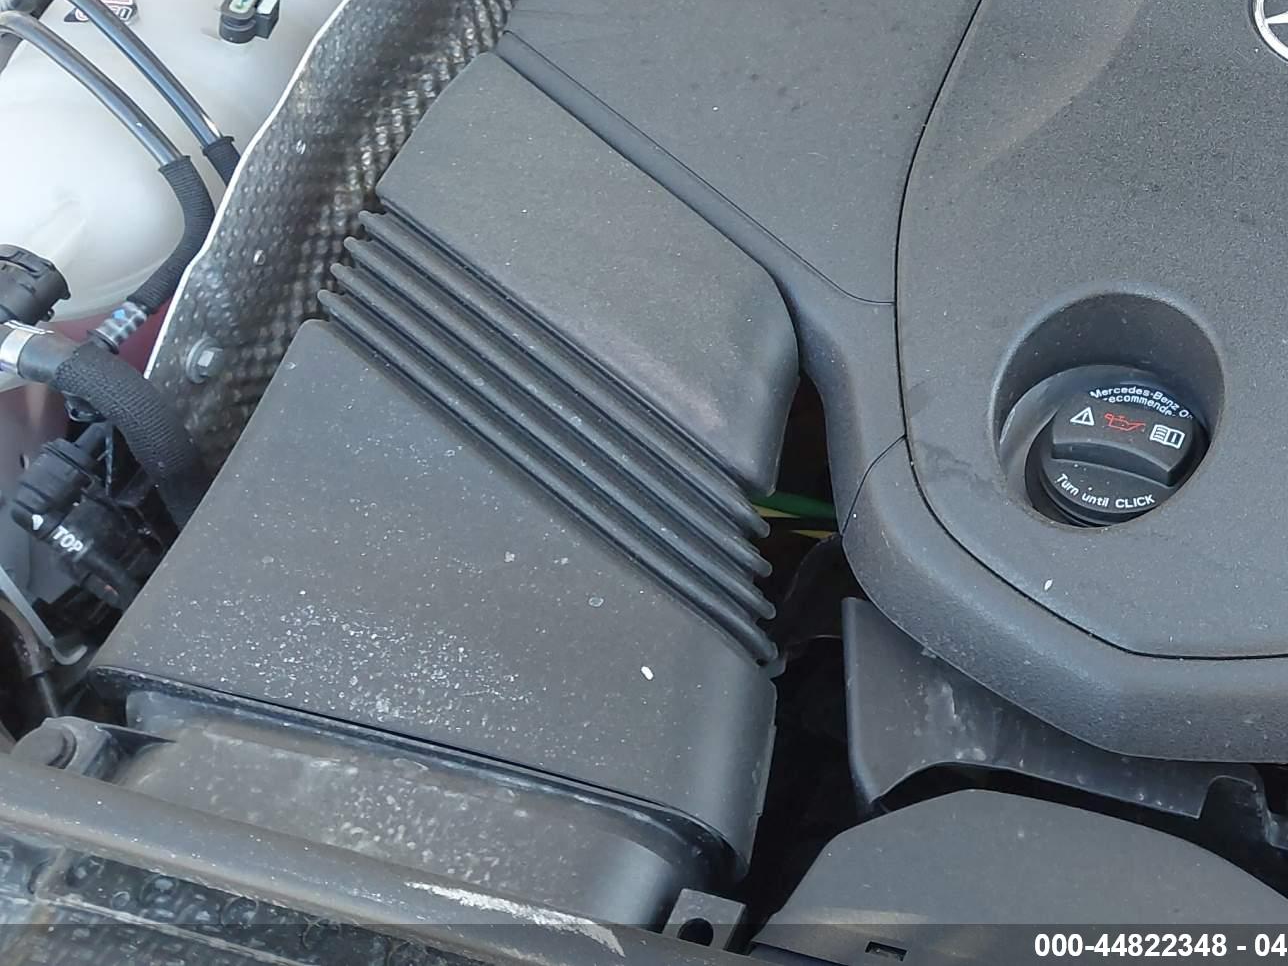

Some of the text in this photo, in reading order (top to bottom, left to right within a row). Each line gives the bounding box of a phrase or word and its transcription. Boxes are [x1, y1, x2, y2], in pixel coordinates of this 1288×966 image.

[1089, 386, 1180, 411] Mercedes-Benz
[1055, 473, 1156, 508] Turn until CLICK
[52, 524, 84, 552] TOP
